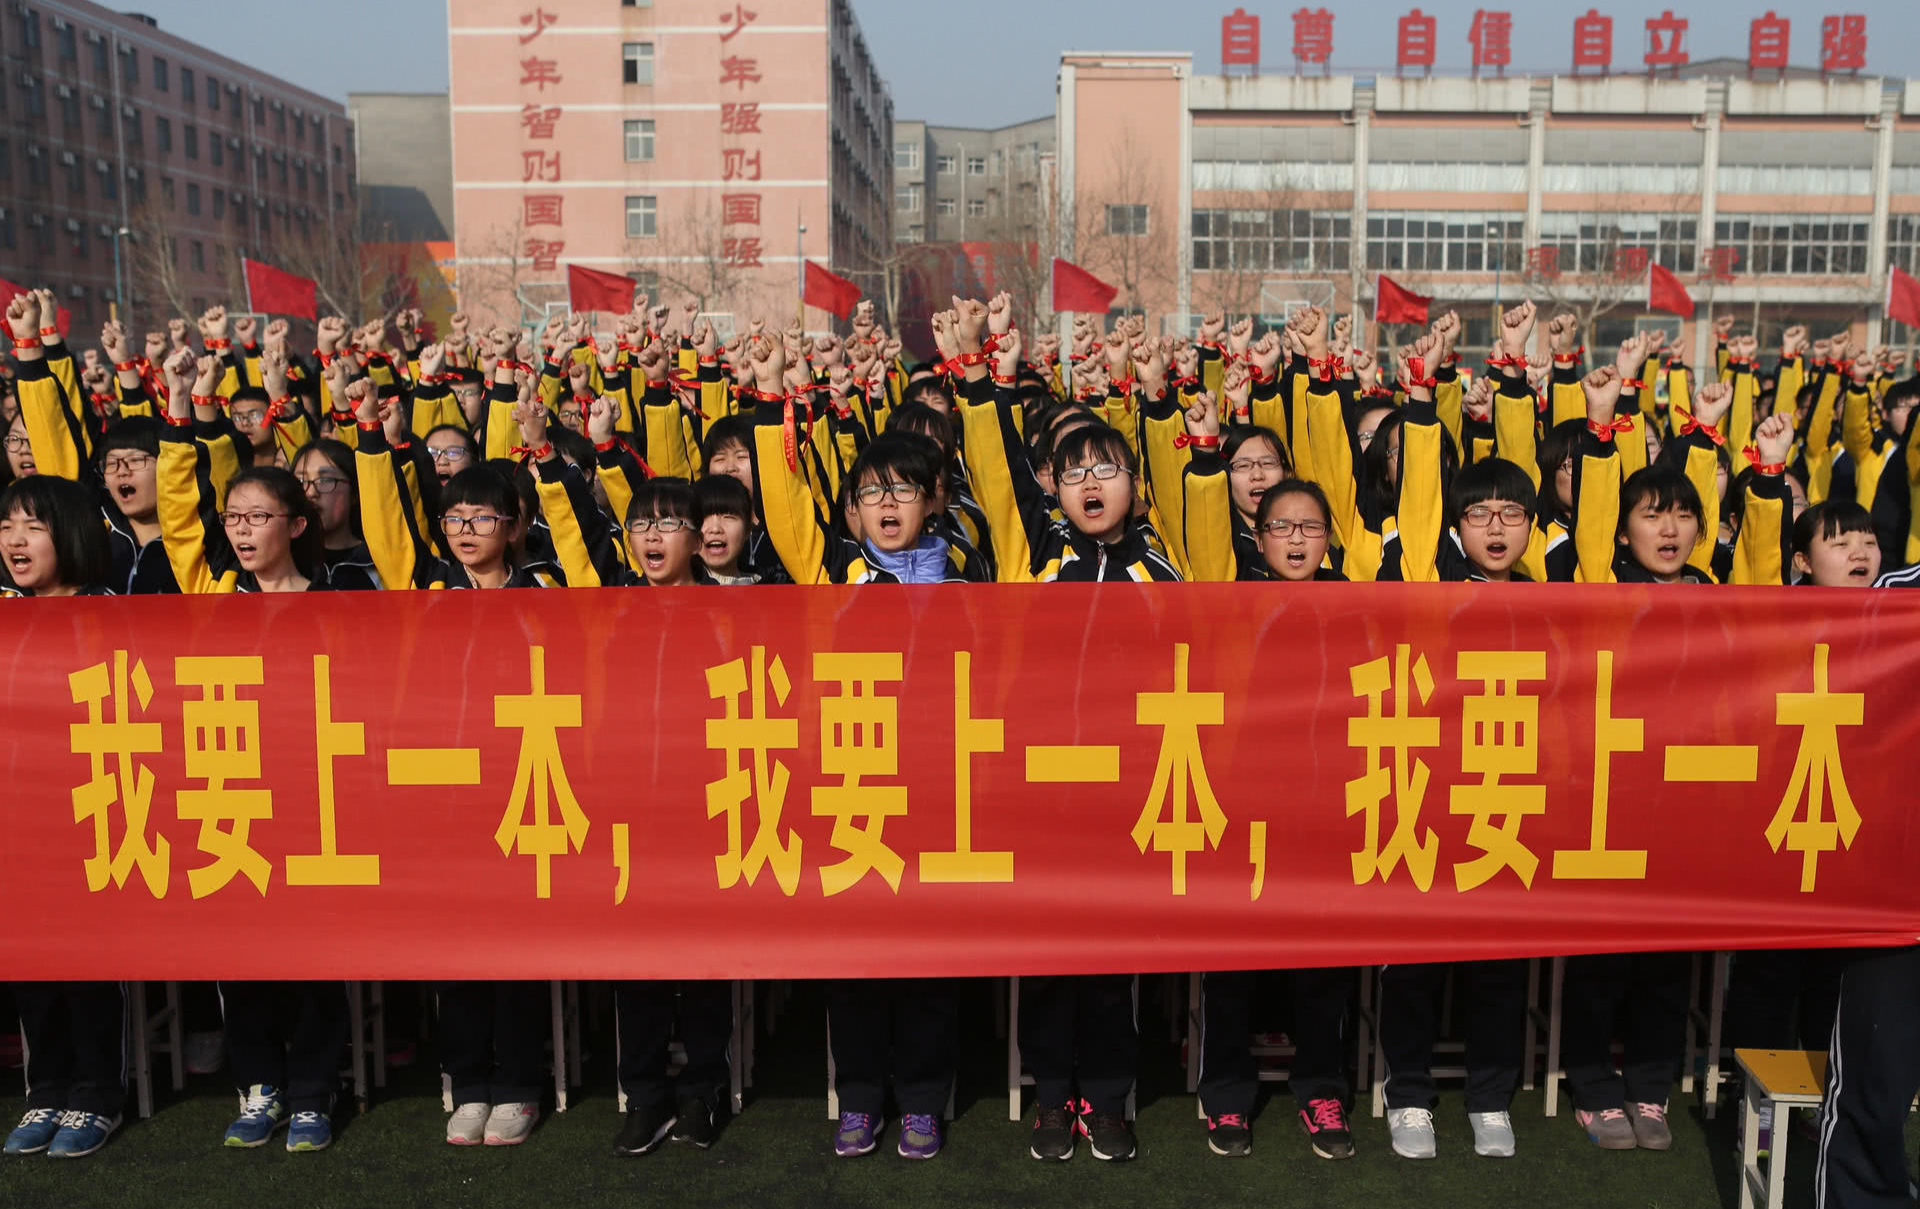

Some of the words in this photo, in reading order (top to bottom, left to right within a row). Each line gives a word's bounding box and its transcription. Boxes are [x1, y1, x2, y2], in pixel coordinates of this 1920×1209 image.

[518, 6, 565, 272] 少年智则国智
[719, 3, 764, 269] 少年强则国强
